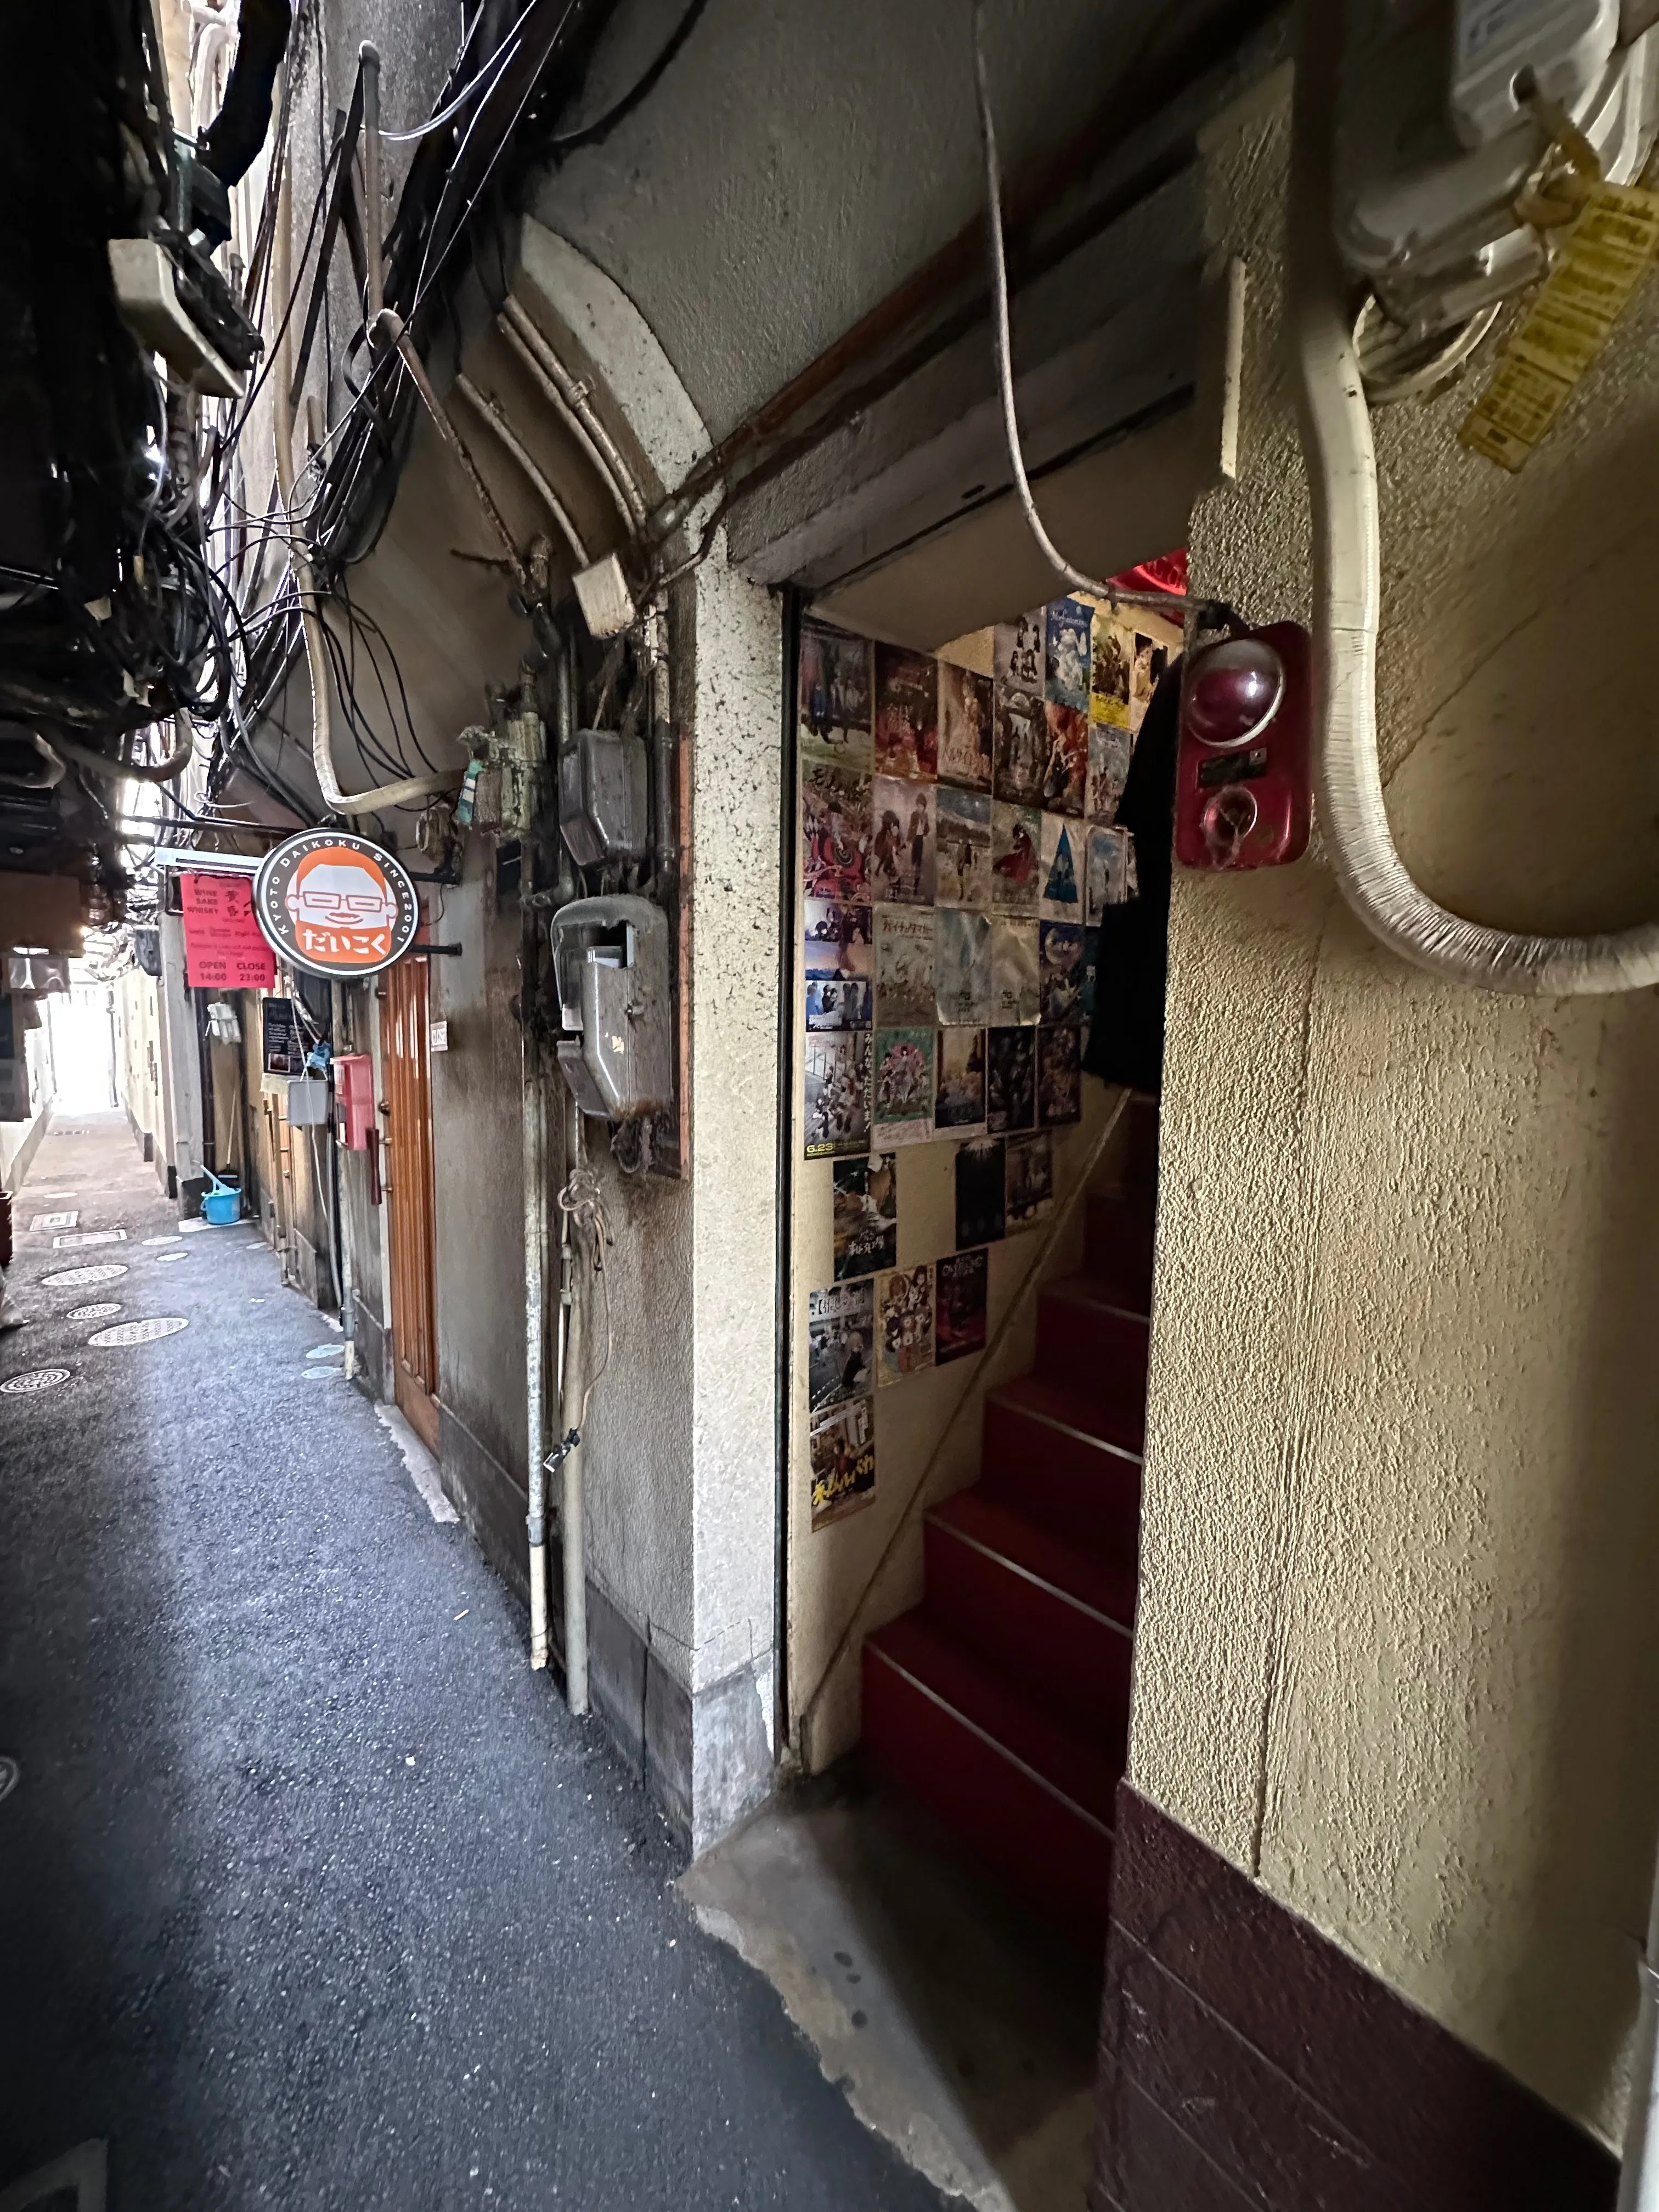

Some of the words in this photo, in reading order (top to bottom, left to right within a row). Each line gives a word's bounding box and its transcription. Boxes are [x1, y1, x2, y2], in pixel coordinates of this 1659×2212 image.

[270, 876, 289, 934] KYOTO
[280, 839, 360, 867] DAIKOKU
[302, 929, 386, 955] だいこく
[199, 961, 226, 969] OPEN
[236, 962, 266, 970] CLOSE
[806, 1143, 833, 1153] 6.23
